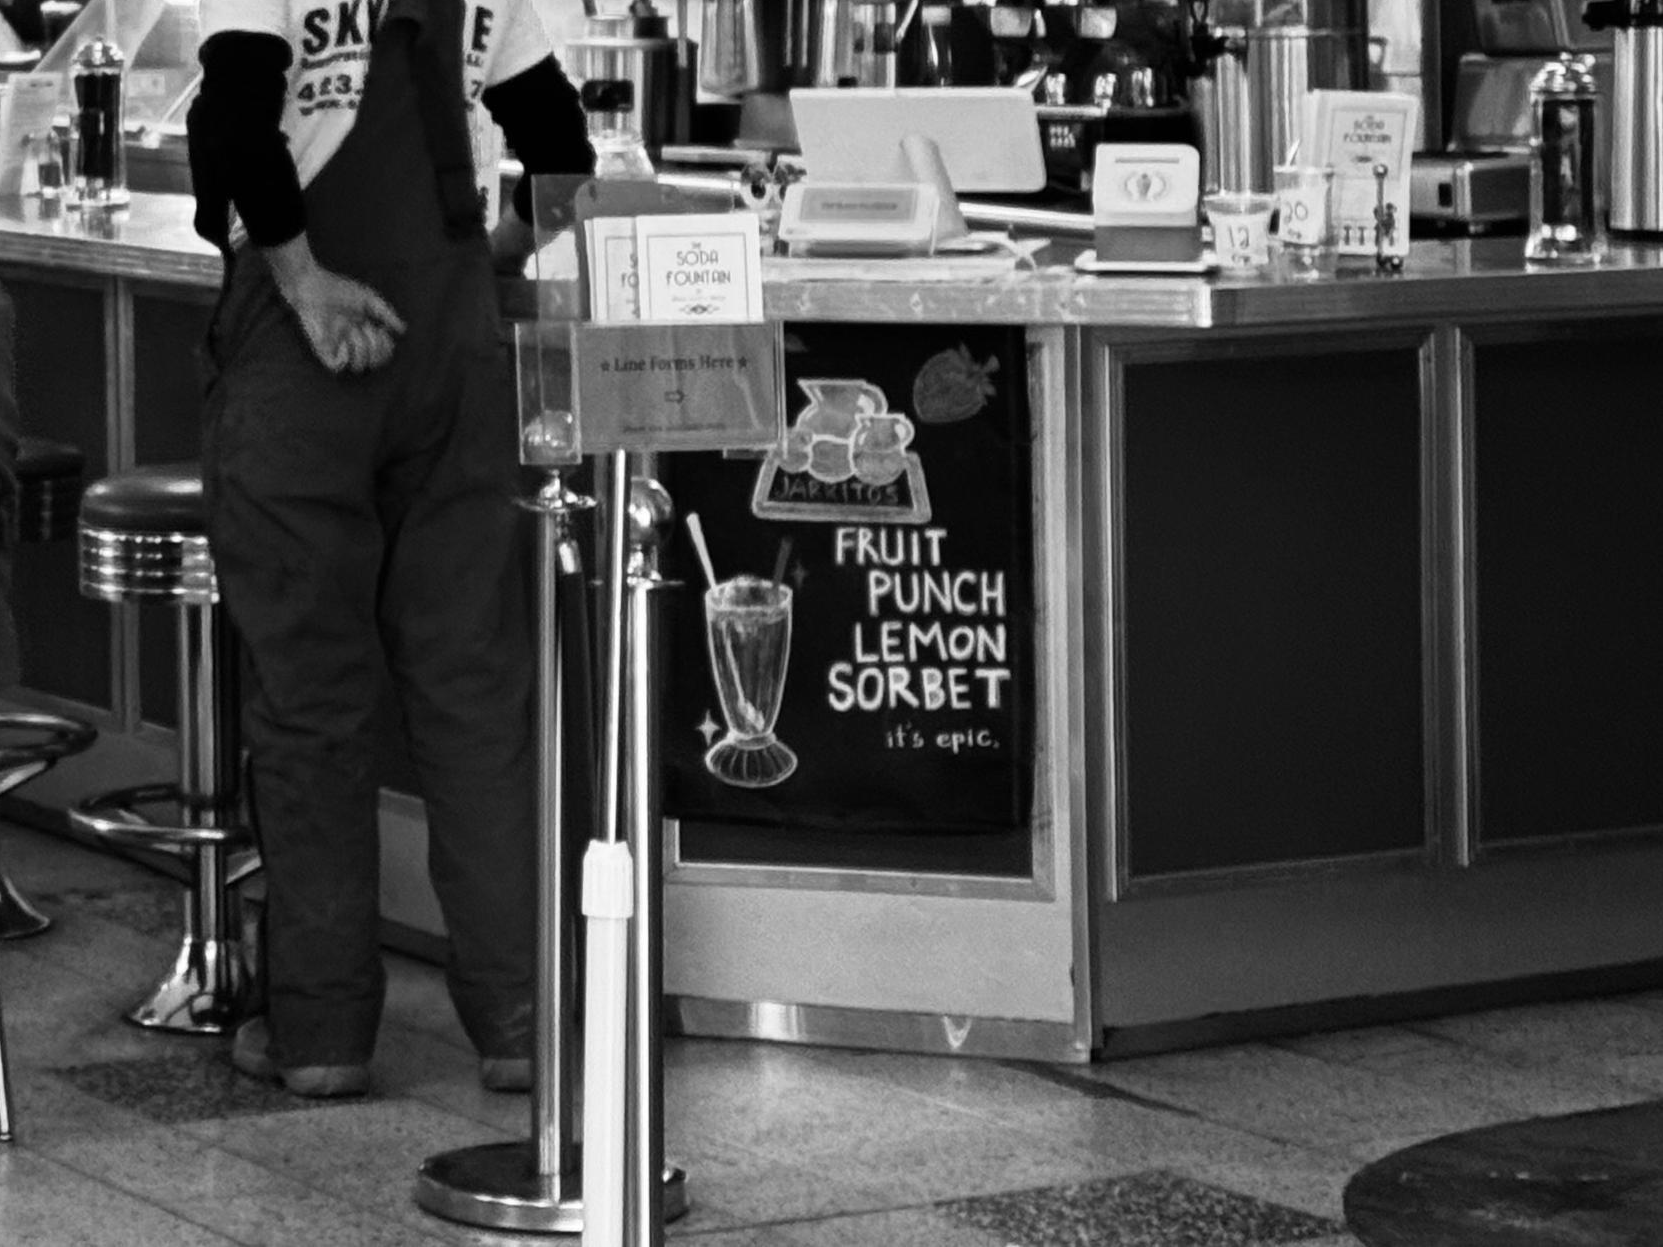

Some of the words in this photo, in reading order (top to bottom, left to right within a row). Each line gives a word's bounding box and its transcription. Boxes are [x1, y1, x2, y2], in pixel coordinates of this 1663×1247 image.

[676, 250, 720, 266] SODA
[665, 269, 732, 286] FOUNTAIN
[613, 357, 646, 372] Line
[650, 355, 696, 372] Forms
[700, 354, 734, 370] Here
[835, 528, 947, 567] FRUIT
[867, 571, 1006, 617] PUNCH
[853, 622, 1007, 663] LEMON
[828, 663, 1011, 712] SORBET
[885, 721, 925, 749] it's
[935, 727, 1001, 753] epic.
